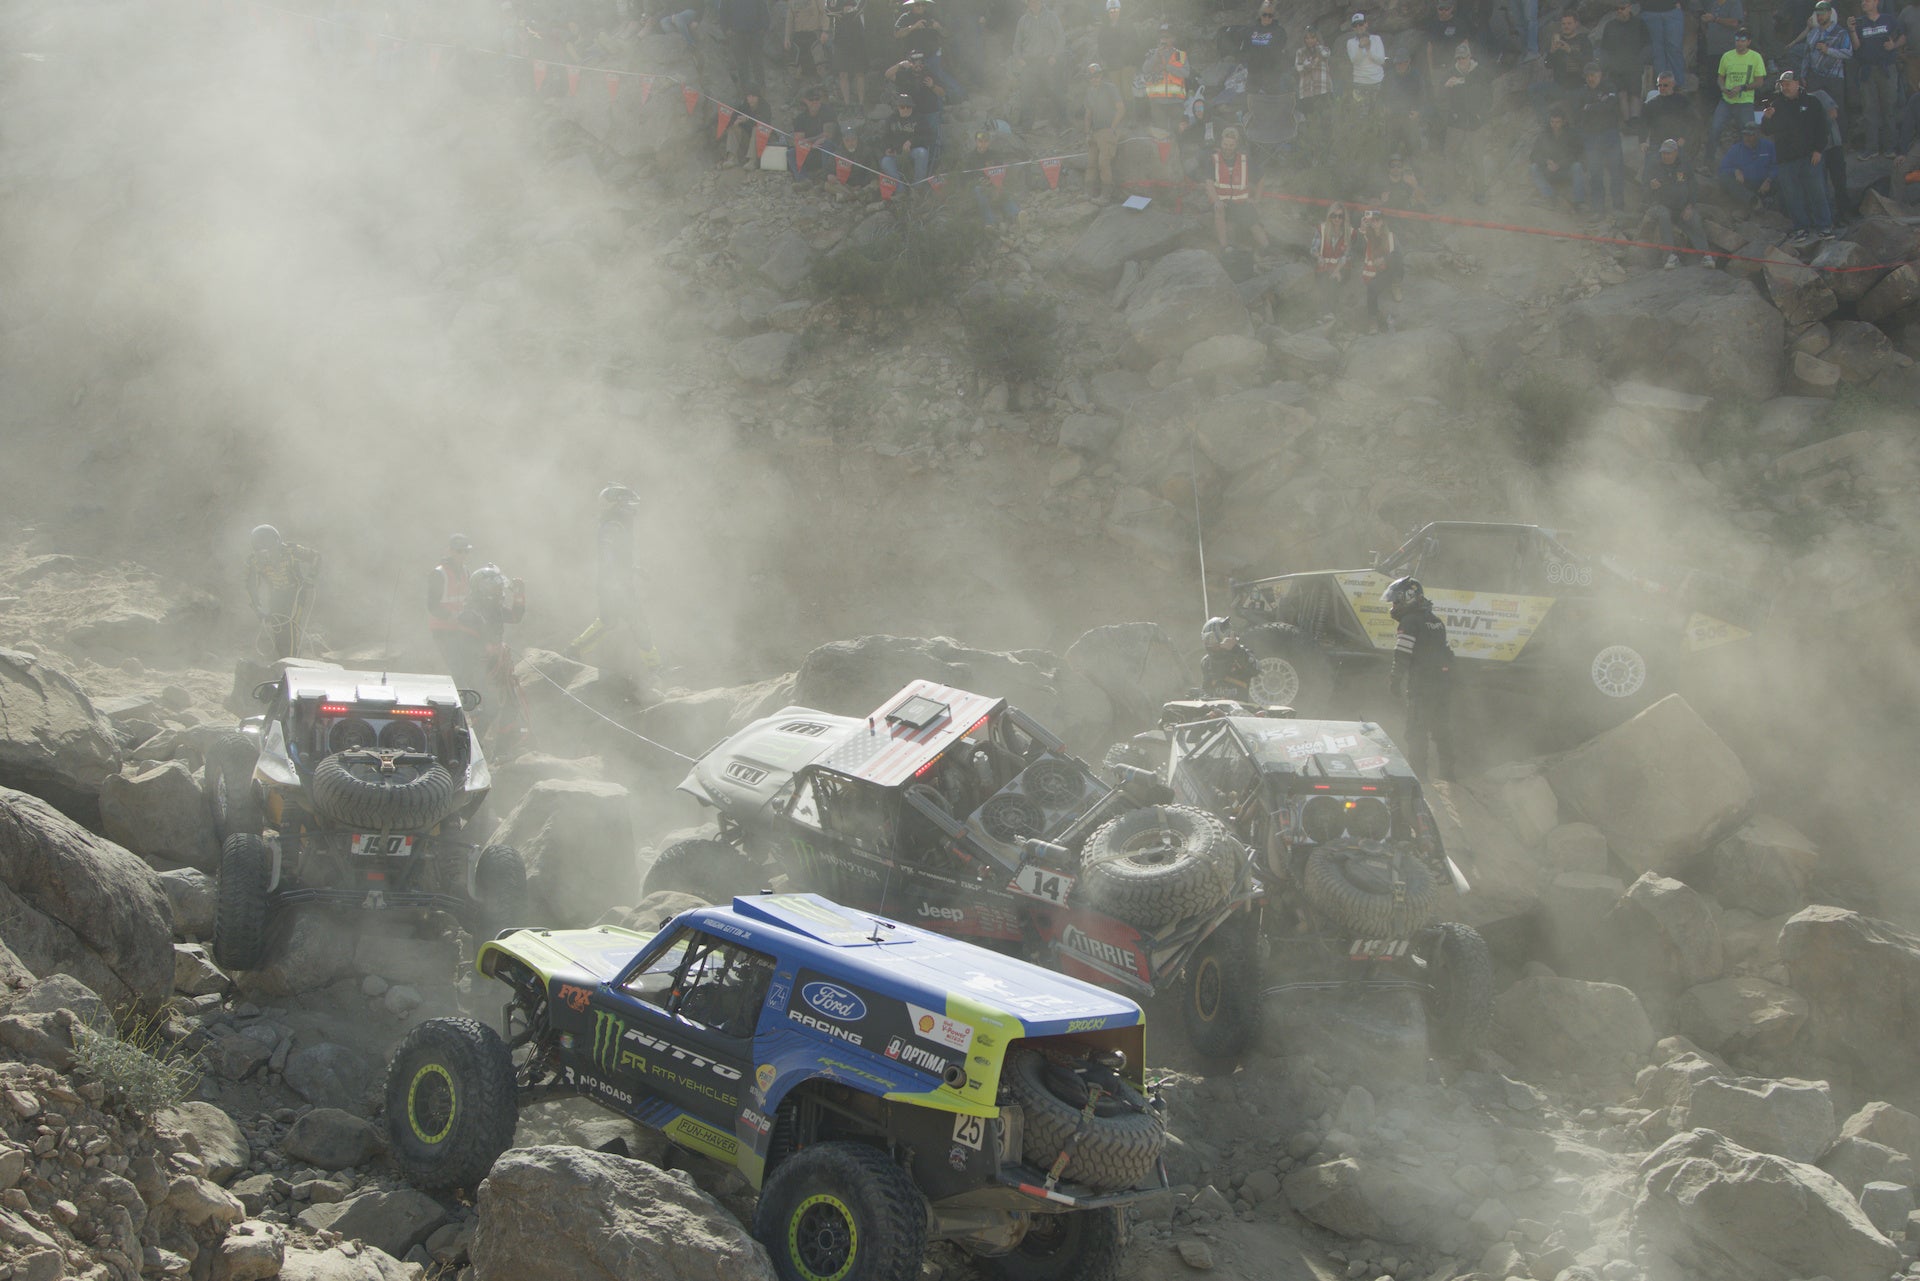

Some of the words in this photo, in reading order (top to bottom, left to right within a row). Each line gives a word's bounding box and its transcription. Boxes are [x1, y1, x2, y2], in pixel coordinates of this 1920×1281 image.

[1546, 561, 1593, 586] 906
[1446, 614, 1498, 630] M/T
[1032, 871, 1060, 901] 14
[916, 901, 965, 923] Jeep
[1062, 923, 1138, 972] CURRIE
[558, 984, 593, 1013] FOX
[812, 986, 856, 1017] Ford
[788, 1009, 864, 1046] RACING
[1065, 1016, 1107, 1034] BROCKY
[623, 1028, 743, 1080] NITTO
[901, 1044, 946, 1074] OPTIMA
[580, 1074, 598, 1087] NO
[599, 1081, 633, 1105] ROADS
[651, 1064, 677, 1082] RTR
[678, 1075, 739, 1107] VEHICLES
[680, 1119, 736, 1151] FUN-HAVER
[956, 1113, 980, 1145] 25
